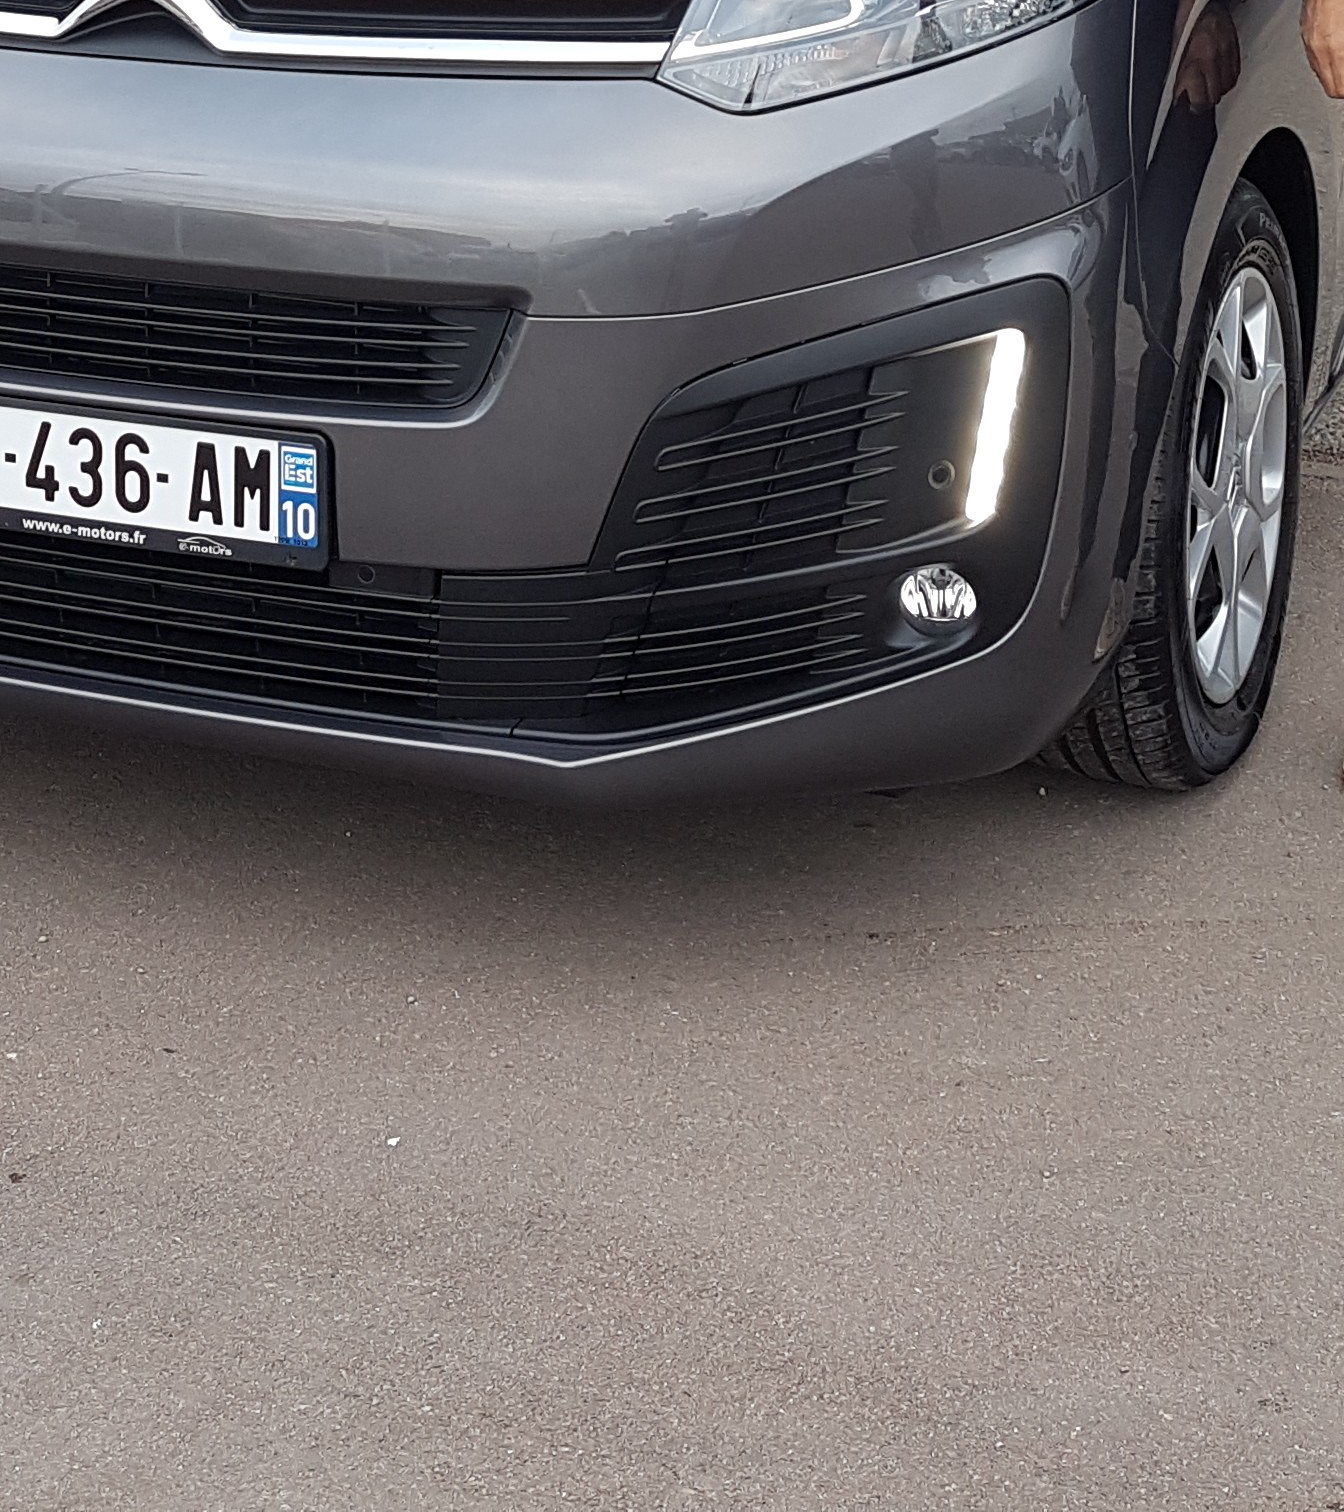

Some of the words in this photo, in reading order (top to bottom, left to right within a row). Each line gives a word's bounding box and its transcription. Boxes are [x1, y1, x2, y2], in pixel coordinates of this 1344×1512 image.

[284, 453, 313, 466] Grand
[284, 464, 313, 484] Est
[22, 518, 147, 545] www.e-motors.fr
[281, 500, 316, 540] 10
